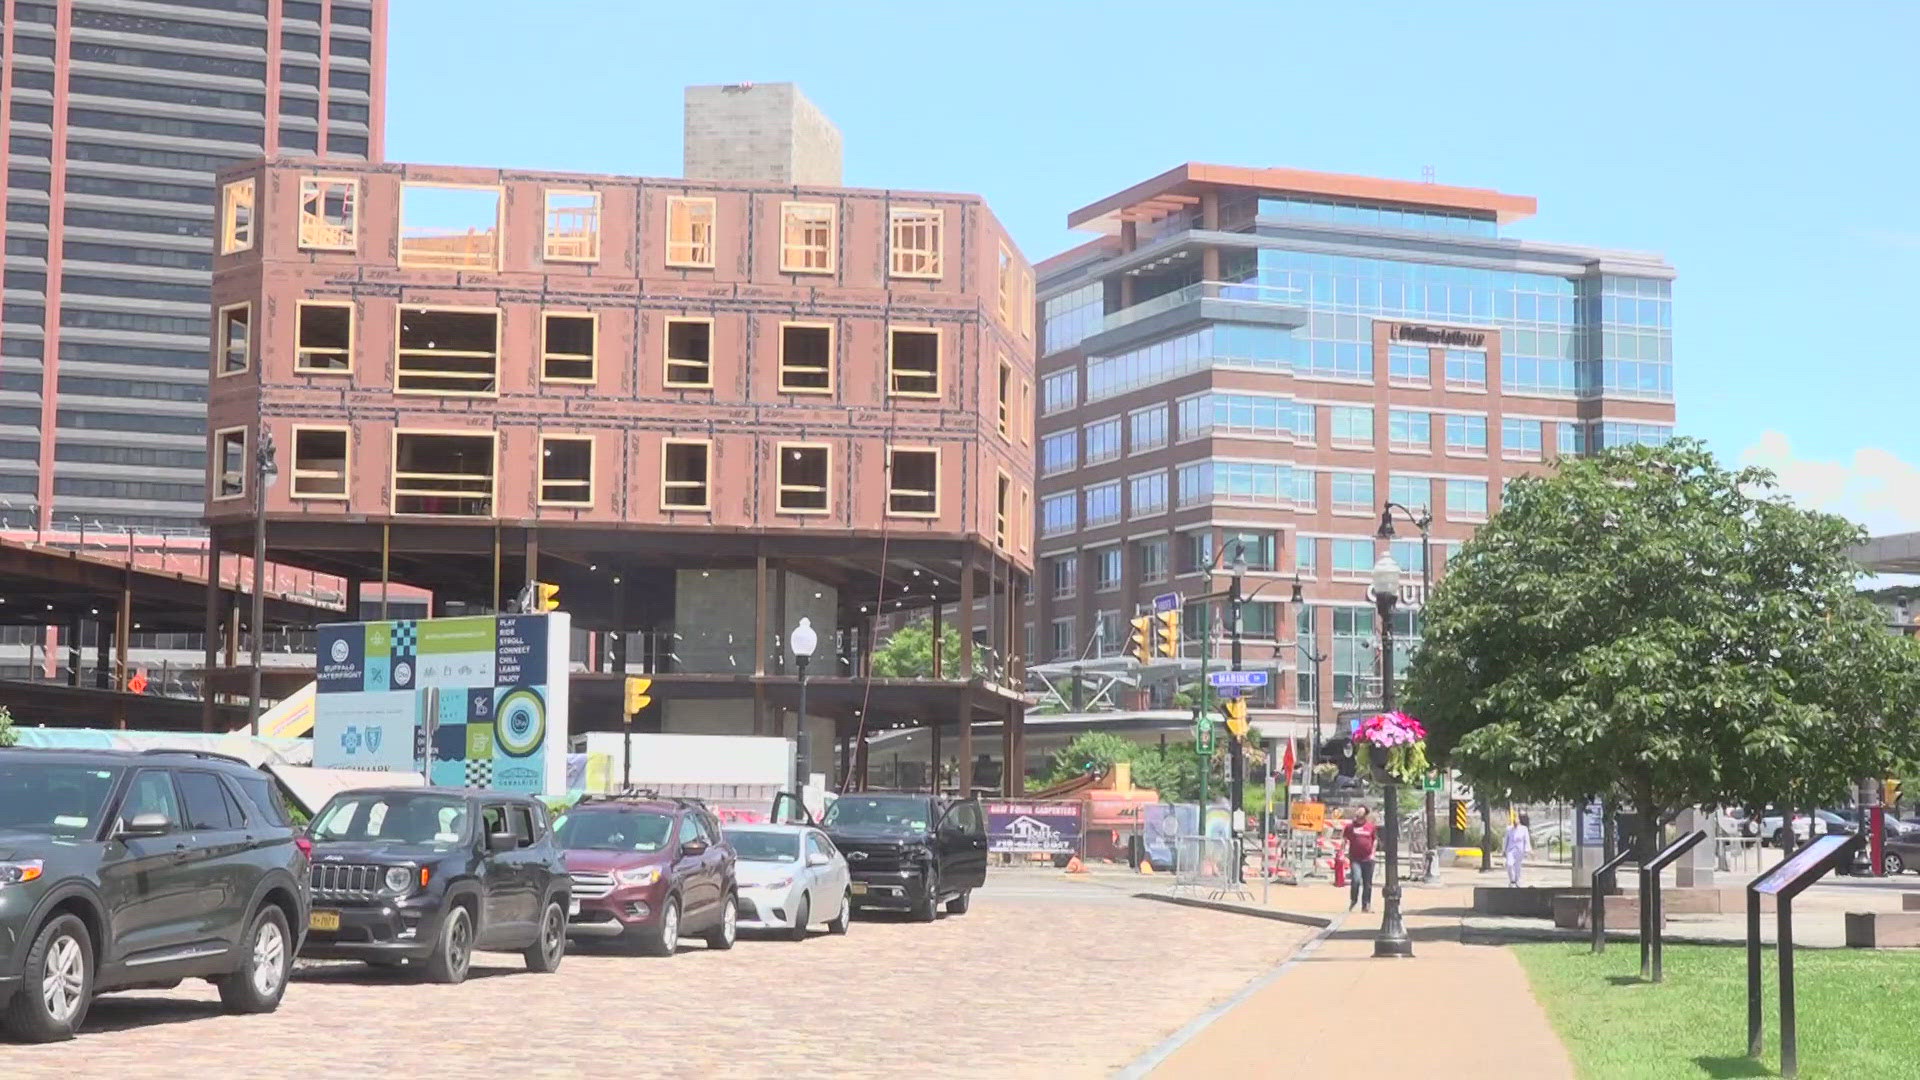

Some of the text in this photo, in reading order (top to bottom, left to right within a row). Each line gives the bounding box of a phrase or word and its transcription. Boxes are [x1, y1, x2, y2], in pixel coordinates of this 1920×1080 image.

[499, 646, 531, 654] CONNECT
[499, 656, 518, 664] CHILL
[324, 663, 355, 673] BUFFALO
[499, 665, 521, 673] LEARN
[317, 671, 362, 680] WATERFRONT
[499, 674, 520, 682] ENJOY
[1219, 673, 1249, 685] MARINE
